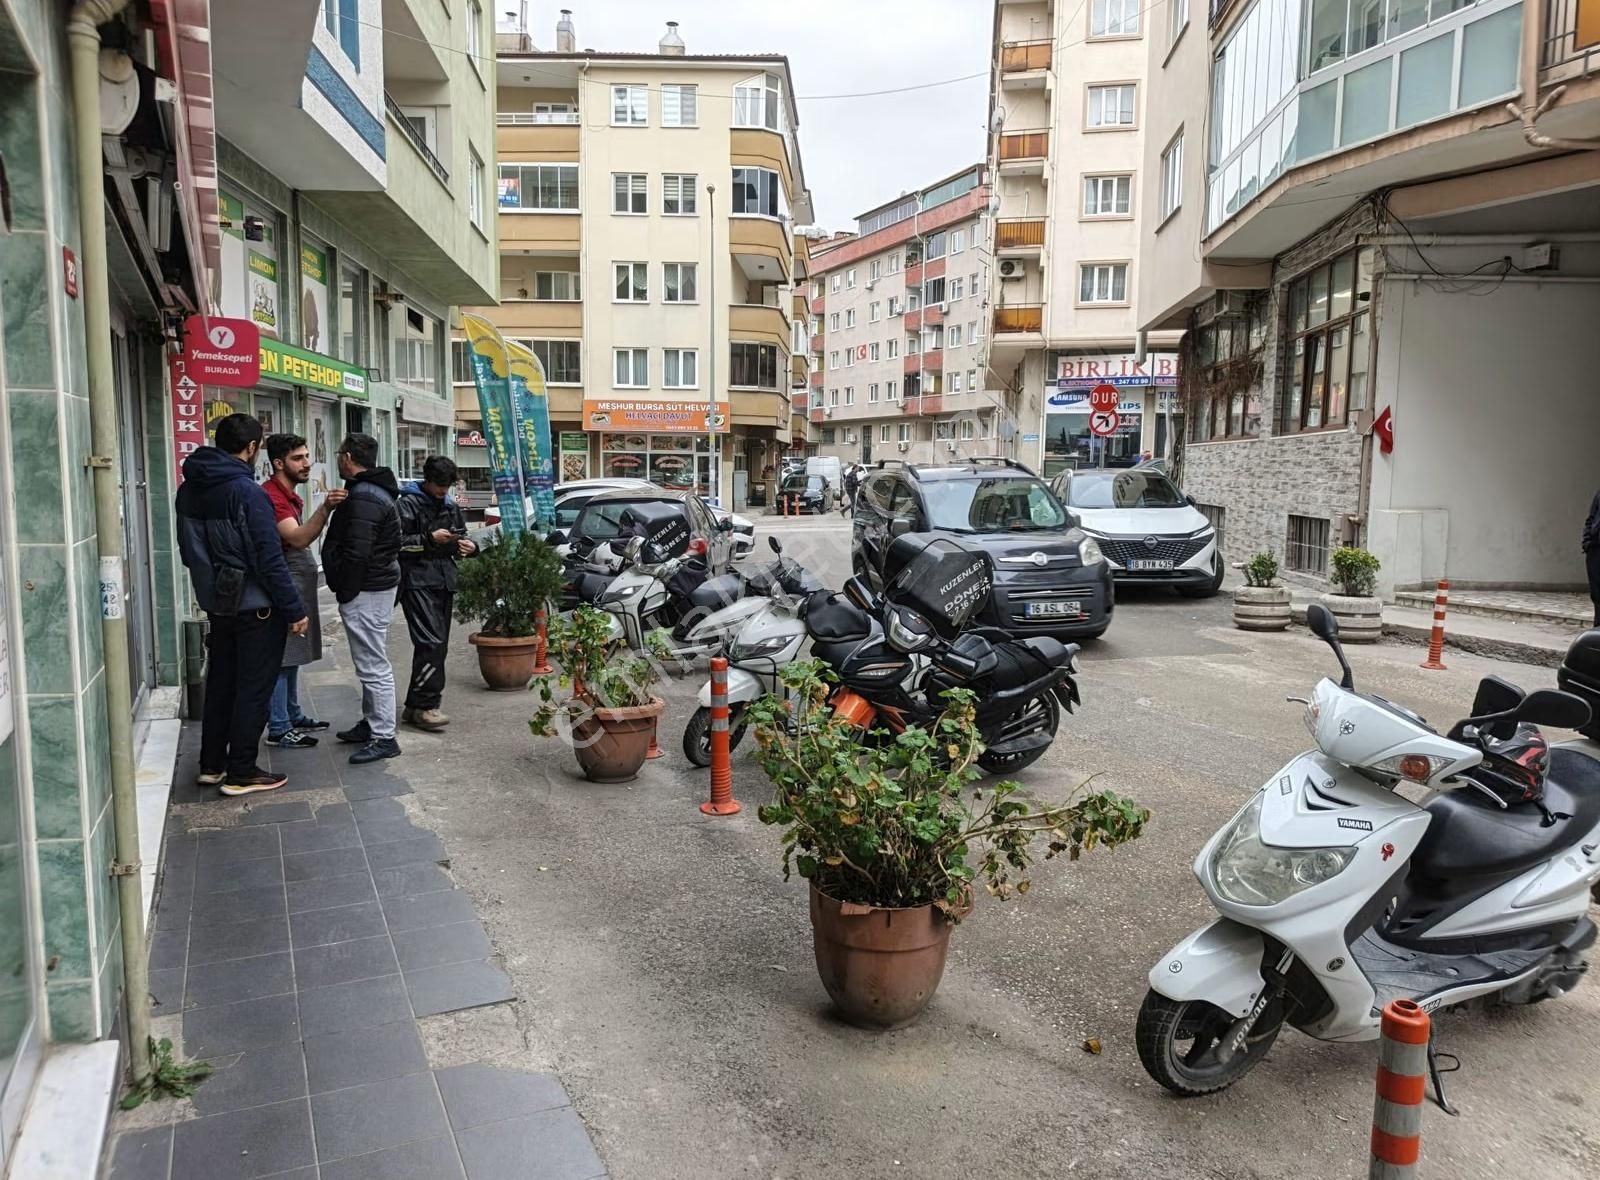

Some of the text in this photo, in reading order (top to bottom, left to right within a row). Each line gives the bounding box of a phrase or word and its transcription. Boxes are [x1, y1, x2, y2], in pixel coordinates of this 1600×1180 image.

[249, 255, 274, 277] LIMON
[191, 349, 253, 364] Yemeksepeti
[204, 366, 241, 376] BURADA
[282, 354, 342, 388] PETSHOP
[1061, 356, 1148, 378] BİRLİK
[1092, 392, 1118, 404] DUR
[636, 402, 664, 411] BURSA
[940, 559, 985, 595] KUZENLER
[1031, 604, 1041, 614] 16
[1043, 603, 1061, 613] ASL
[1339, 819, 1371, 830] YAMAHA
[1231, 995, 1268, 1052] DUNLOP
